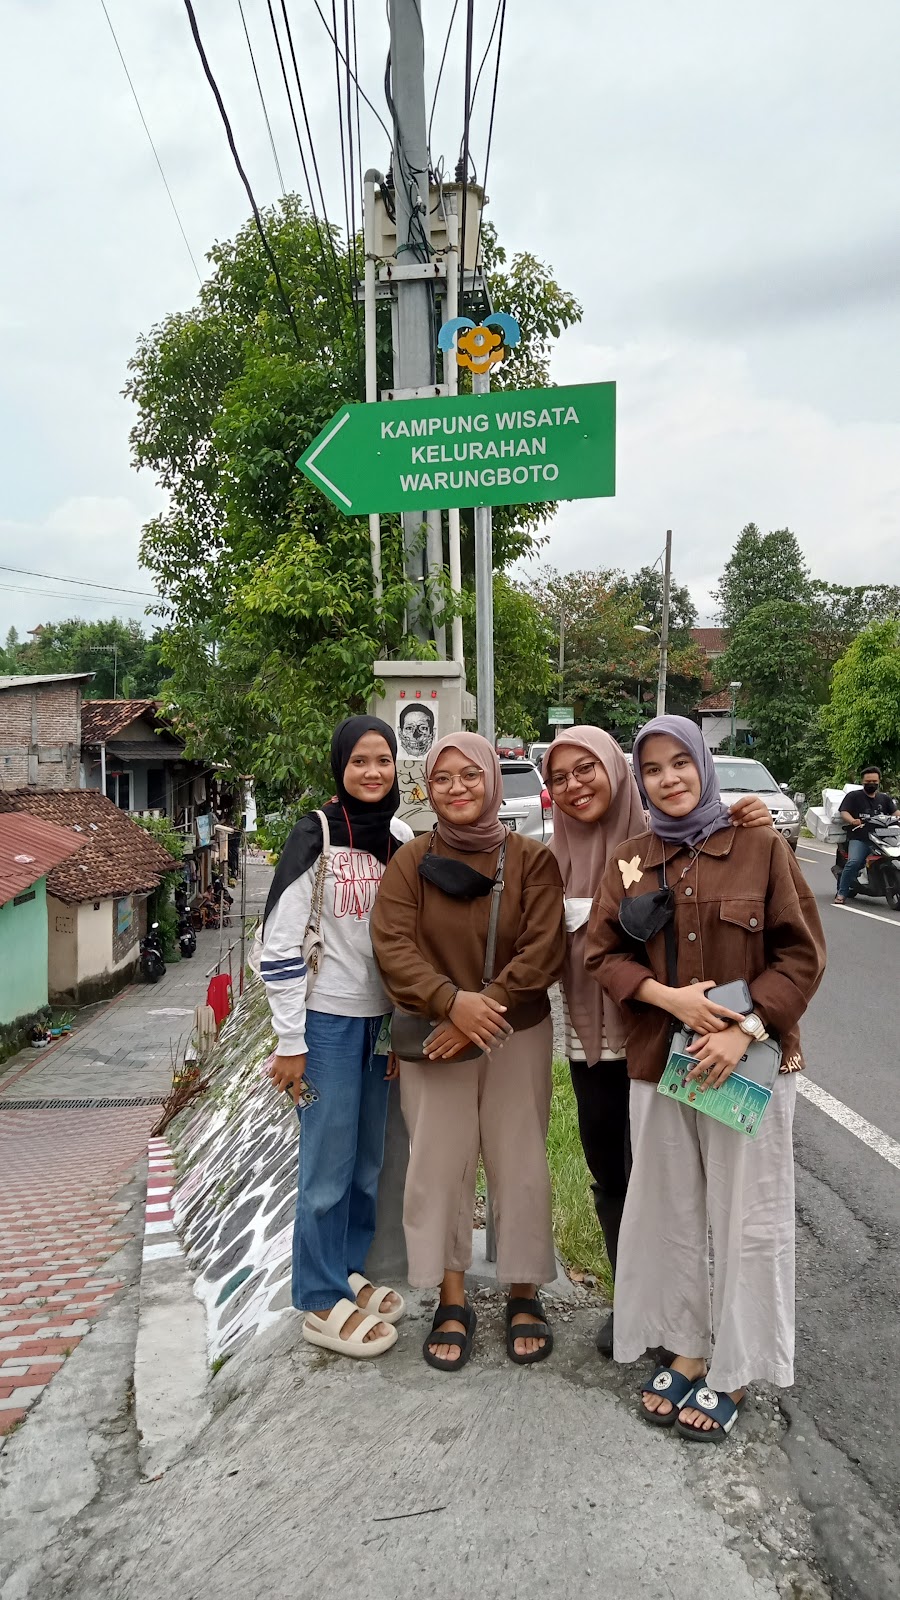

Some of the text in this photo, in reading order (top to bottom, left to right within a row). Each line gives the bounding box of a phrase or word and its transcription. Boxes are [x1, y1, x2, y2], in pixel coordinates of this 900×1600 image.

[380, 406, 580, 439] KAMPUNG WISATA
[411, 436, 547, 464] KELURAHAN
[399, 463, 560, 492] WARUNGBOTO
